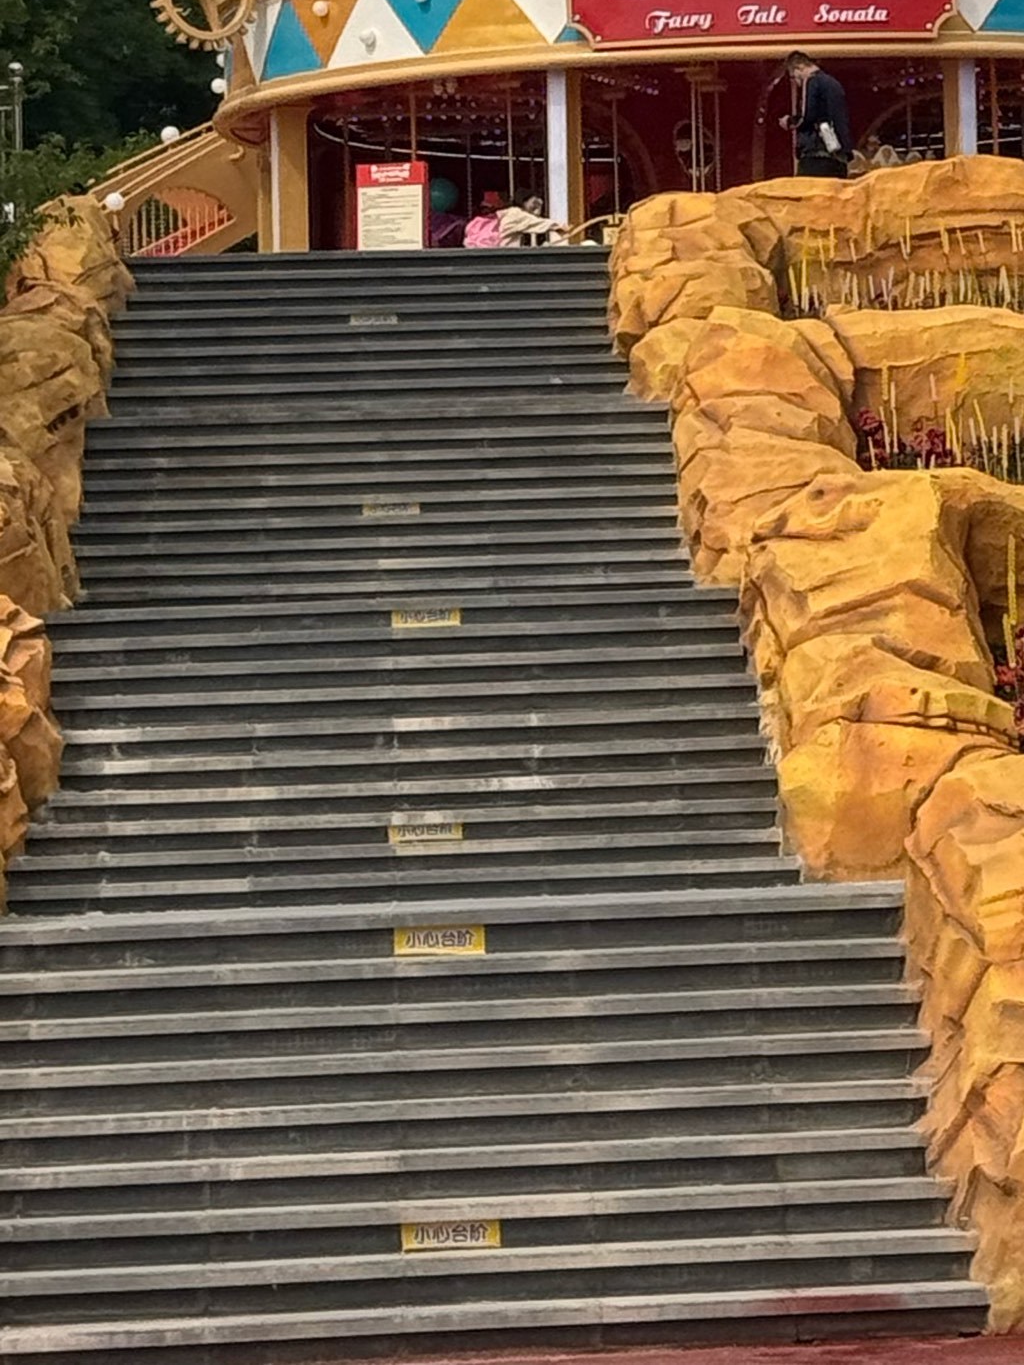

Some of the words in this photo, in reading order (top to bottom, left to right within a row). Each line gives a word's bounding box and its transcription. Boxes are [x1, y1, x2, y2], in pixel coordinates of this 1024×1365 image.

[645, 10, 714, 34] Fairy
[737, 4, 788, 26] Tale
[813, 2, 890, 24] Sonata
[406, 931, 475, 948] 小心台阶
[414, 1223, 488, 1244] 小心台阶
